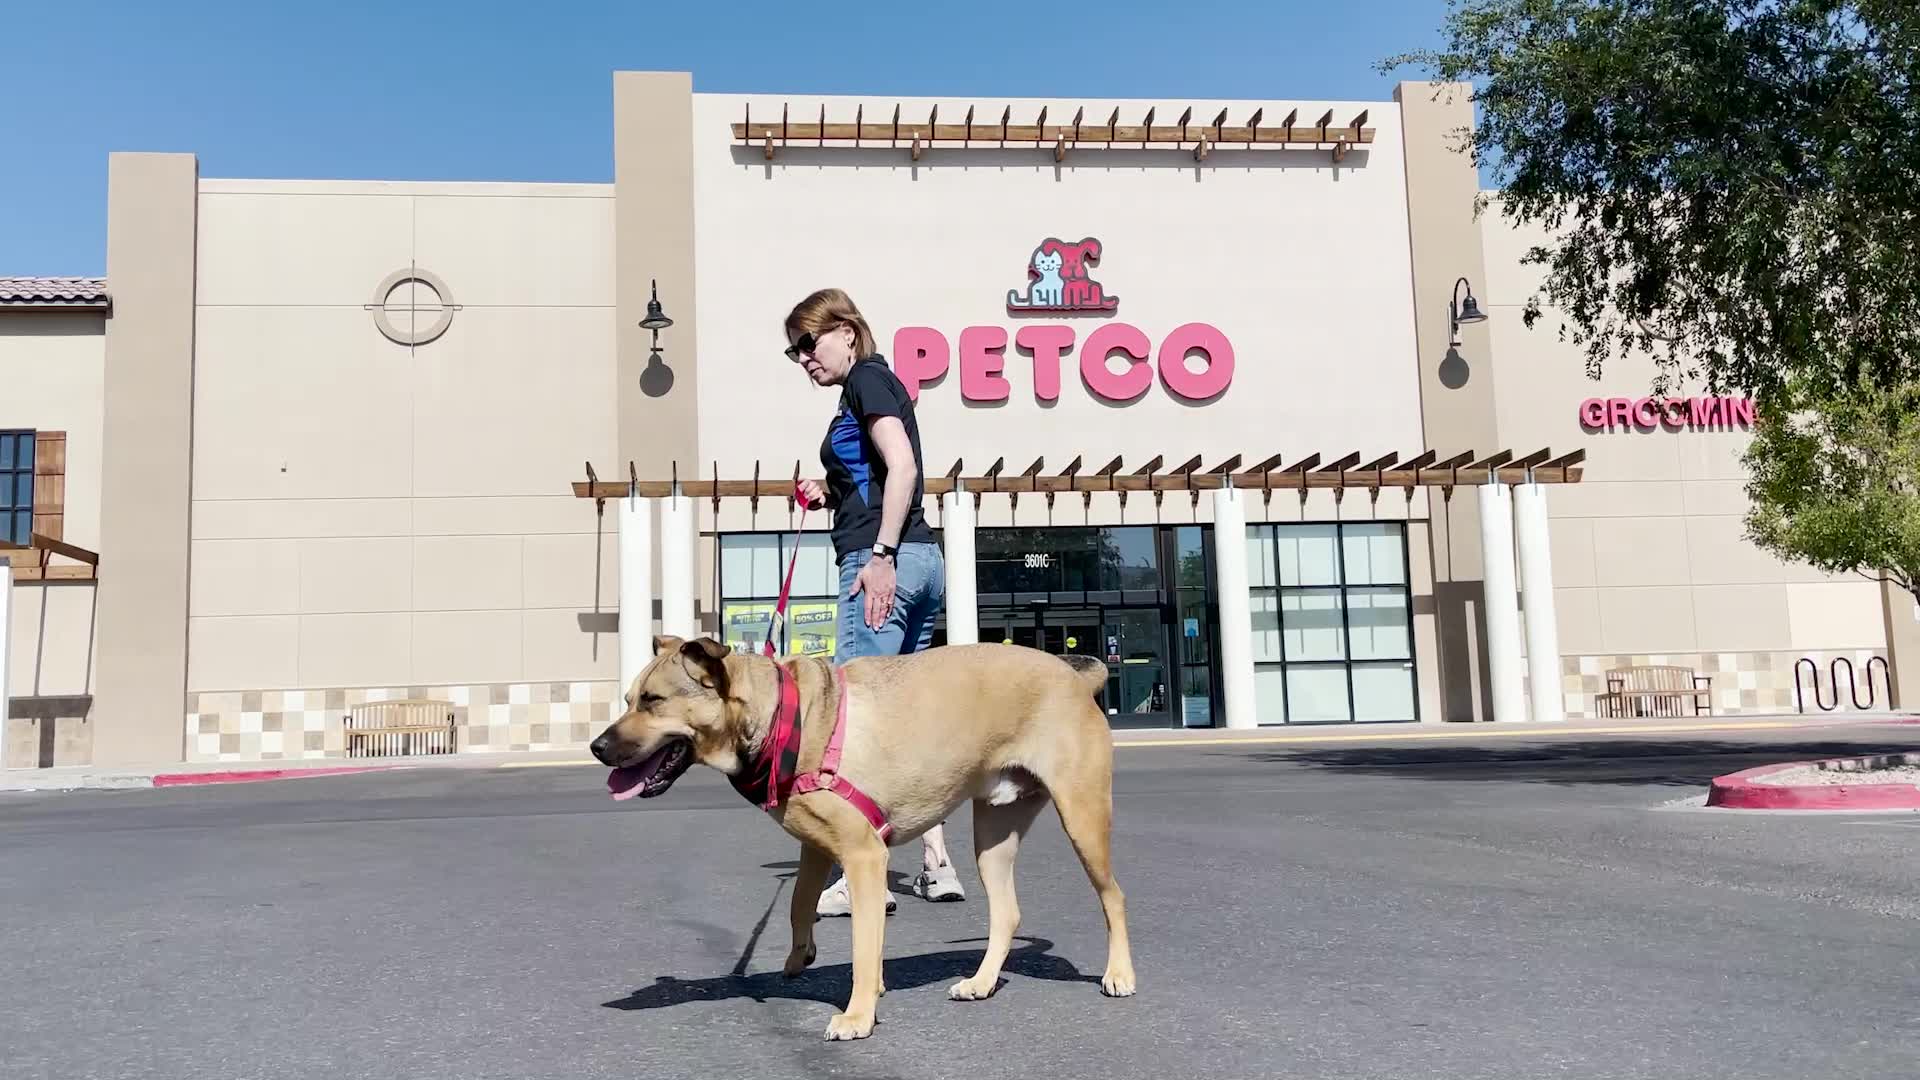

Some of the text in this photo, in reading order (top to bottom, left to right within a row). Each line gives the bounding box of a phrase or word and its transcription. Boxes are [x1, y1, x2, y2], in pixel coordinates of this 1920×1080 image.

[893, 322, 1235, 402] PETCO
[1579, 397, 1760, 427] GROOMIN
[1024, 553, 1050, 568] 3601C
[815, 612, 832, 621] OFF
